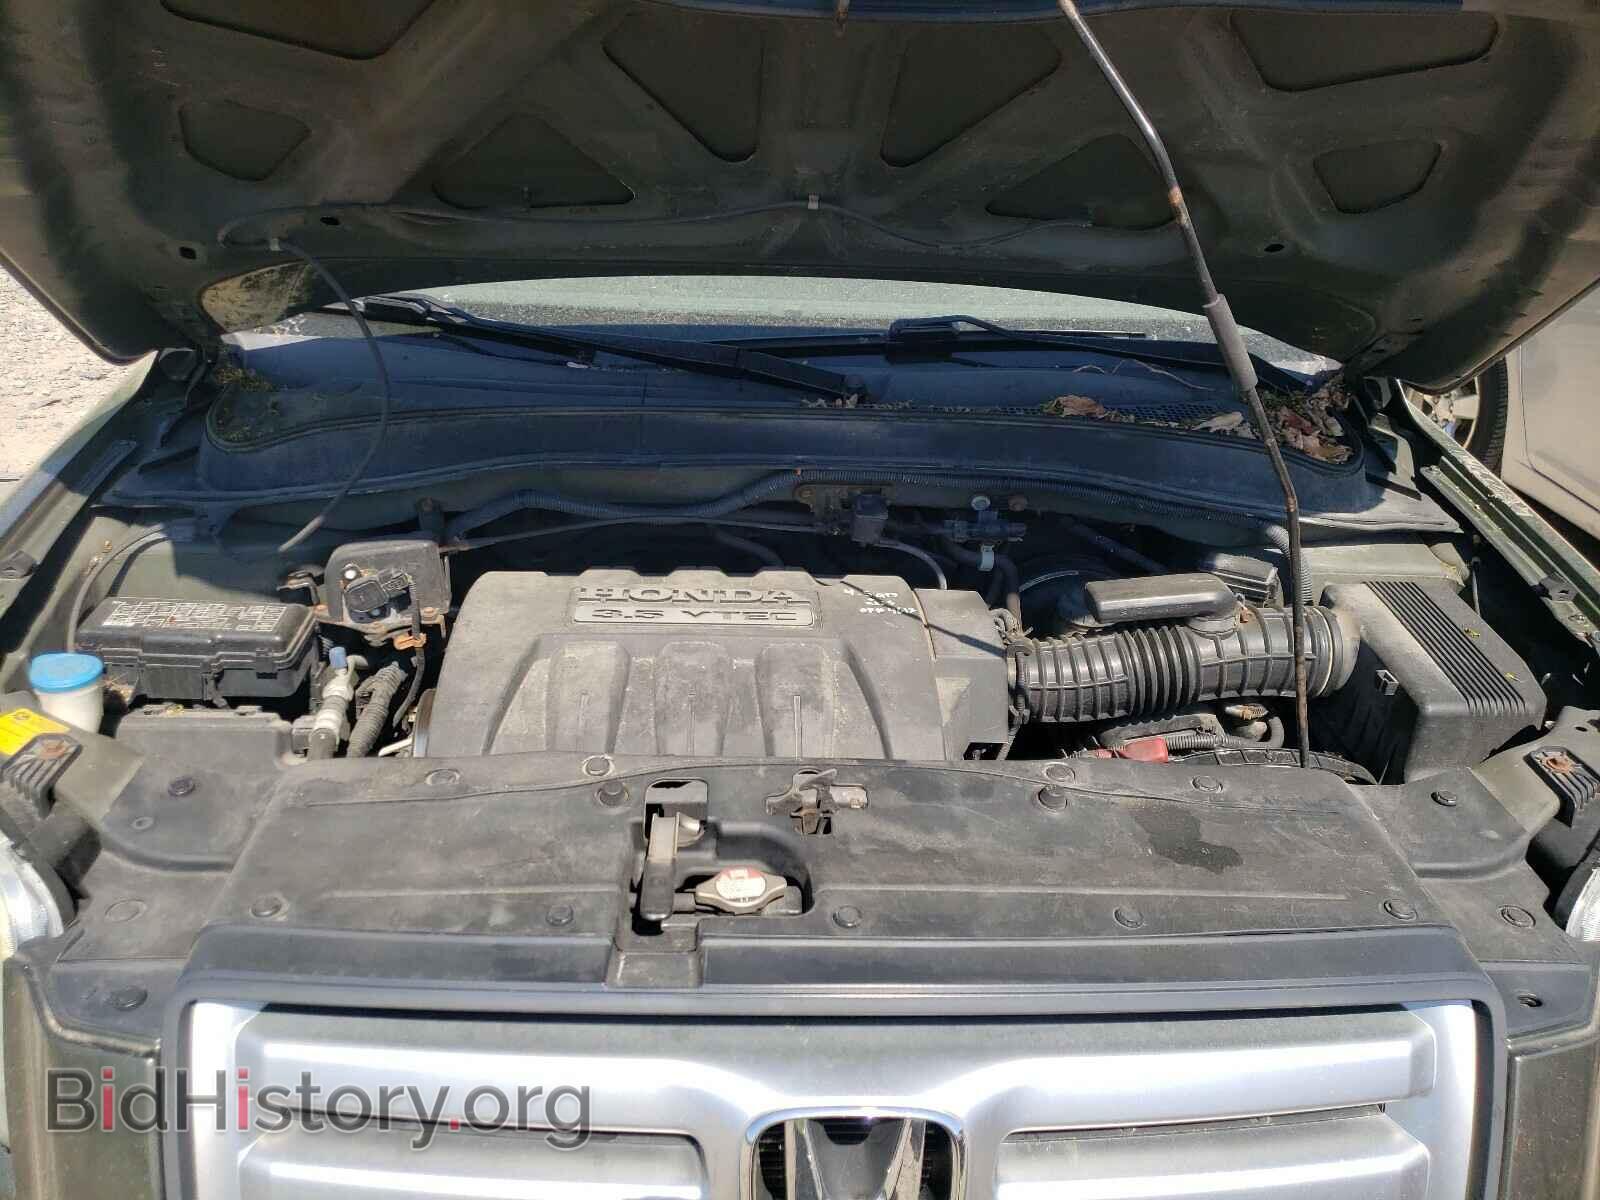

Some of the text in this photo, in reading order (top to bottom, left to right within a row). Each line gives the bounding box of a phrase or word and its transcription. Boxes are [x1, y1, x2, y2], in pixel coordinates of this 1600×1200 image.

[577, 586, 811, 604] HONDA
[592, 608, 798, 622] 3.5 VTEC
